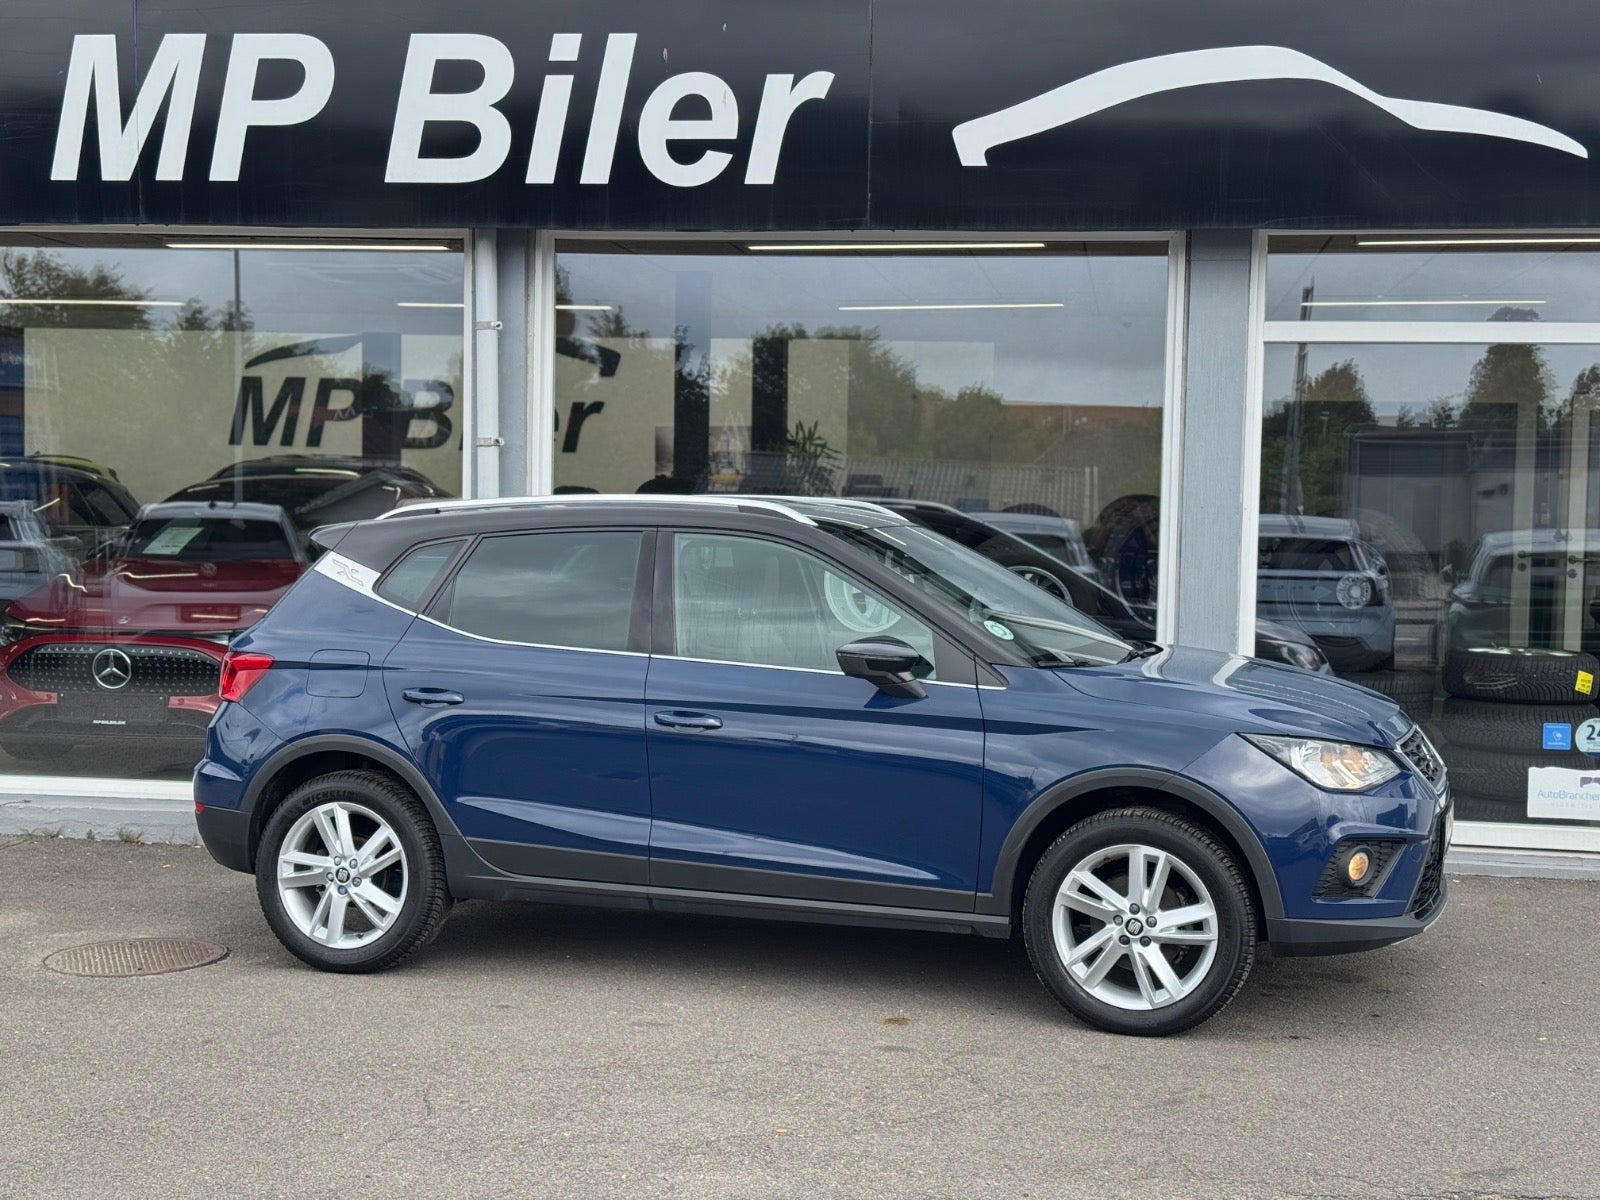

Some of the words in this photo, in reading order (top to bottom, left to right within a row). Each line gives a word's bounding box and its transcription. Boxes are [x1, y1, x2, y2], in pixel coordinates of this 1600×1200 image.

[50, 33, 335, 182] MP
[384, 32, 835, 188] Biler
[228, 375, 363, 448] MP
